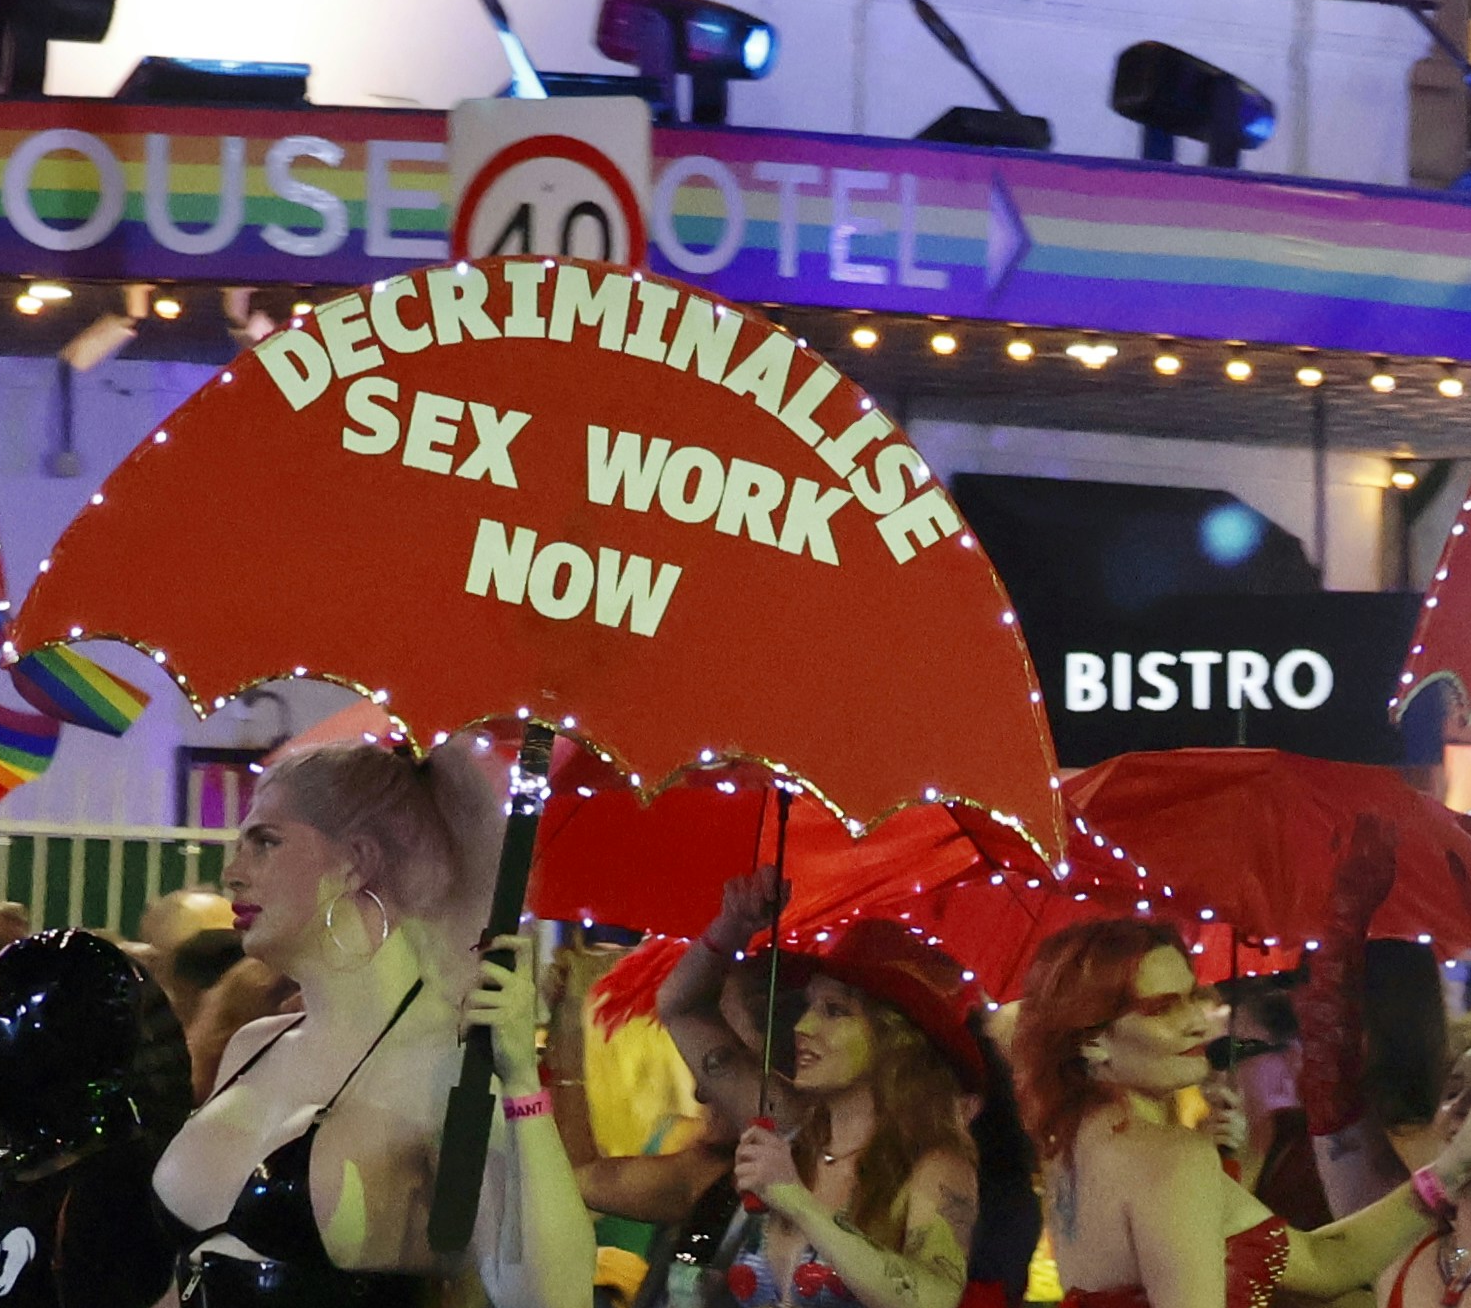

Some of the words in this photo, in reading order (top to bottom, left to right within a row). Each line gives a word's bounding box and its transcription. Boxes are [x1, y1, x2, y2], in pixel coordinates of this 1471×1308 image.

[650, 154, 950, 290] OTEL
[254, 263, 966, 565] DECRIMINALISE
[341, 375, 533, 489] SEX
[586, 424, 856, 567] WORK
[464, 517, 683, 639] NOW
[1064, 648, 1334, 712] BISTRO
